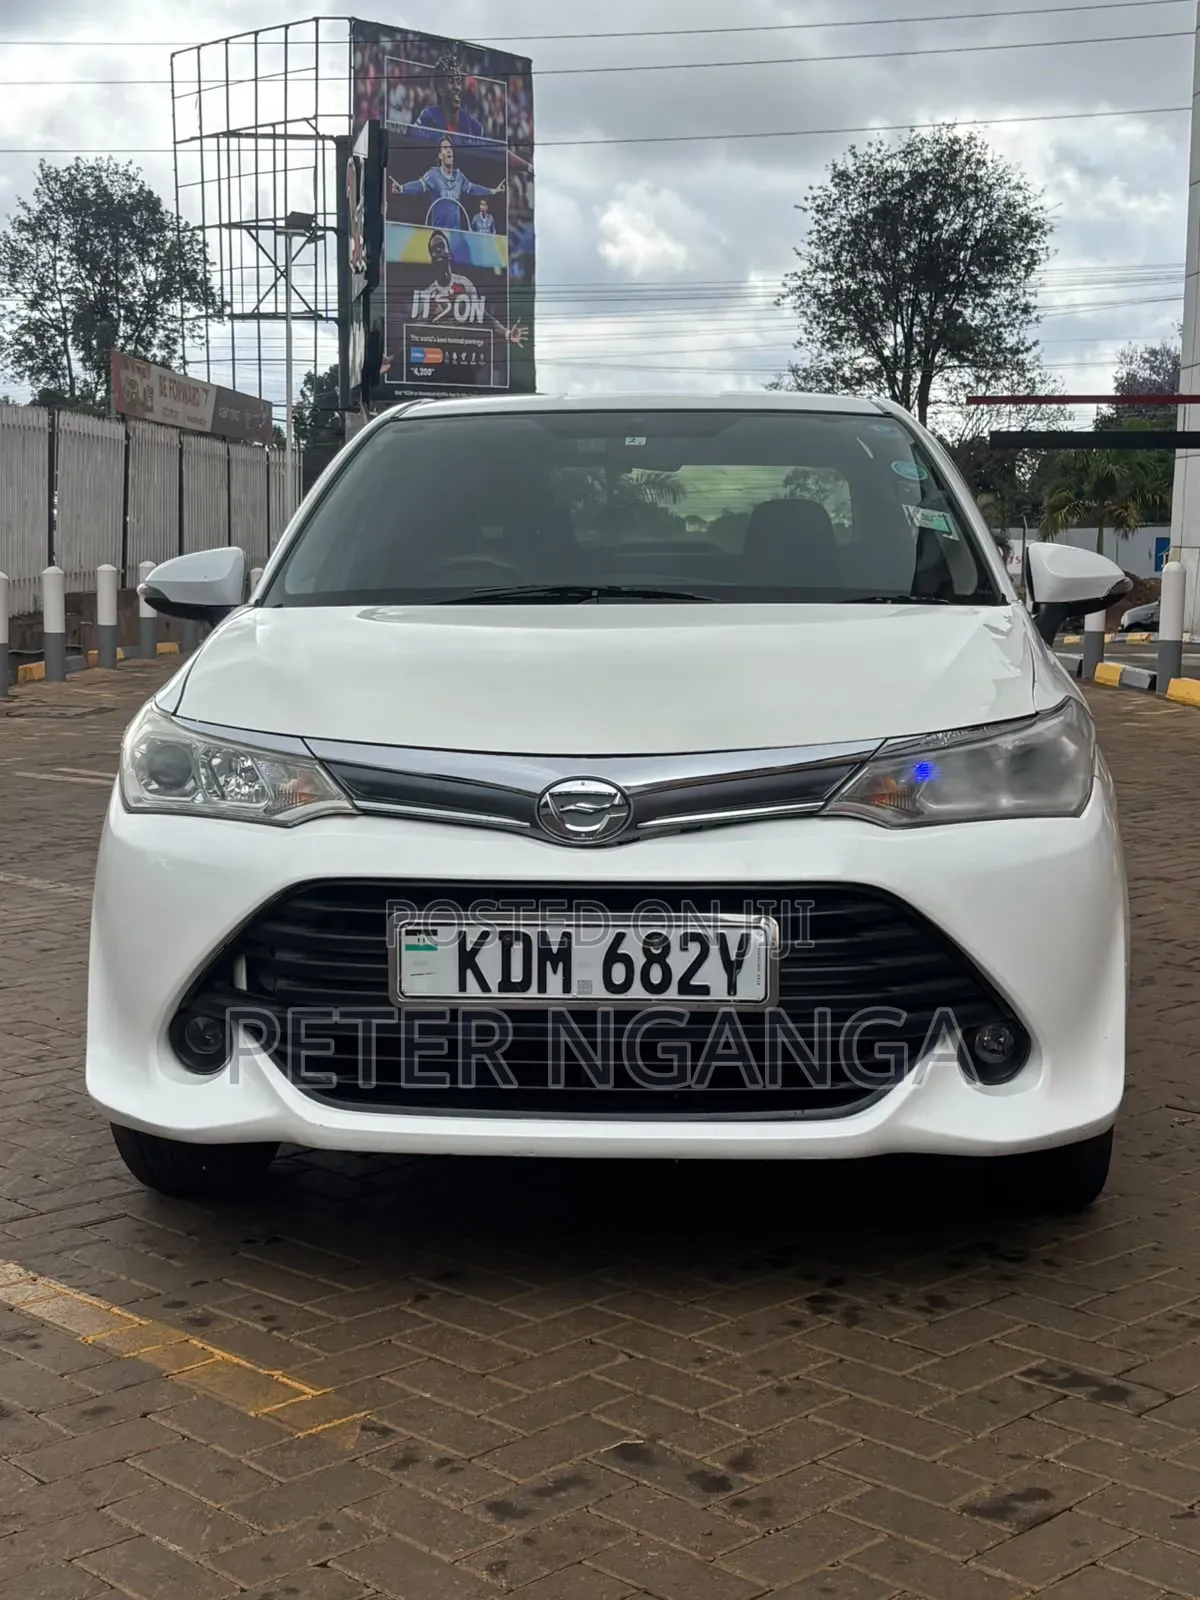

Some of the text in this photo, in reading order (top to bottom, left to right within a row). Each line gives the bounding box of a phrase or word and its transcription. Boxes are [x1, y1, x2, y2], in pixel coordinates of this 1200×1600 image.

[454, 294, 486, 323] ON
[458, 930, 572, 994] KDM
[602, 931, 751, 996] 682Y
